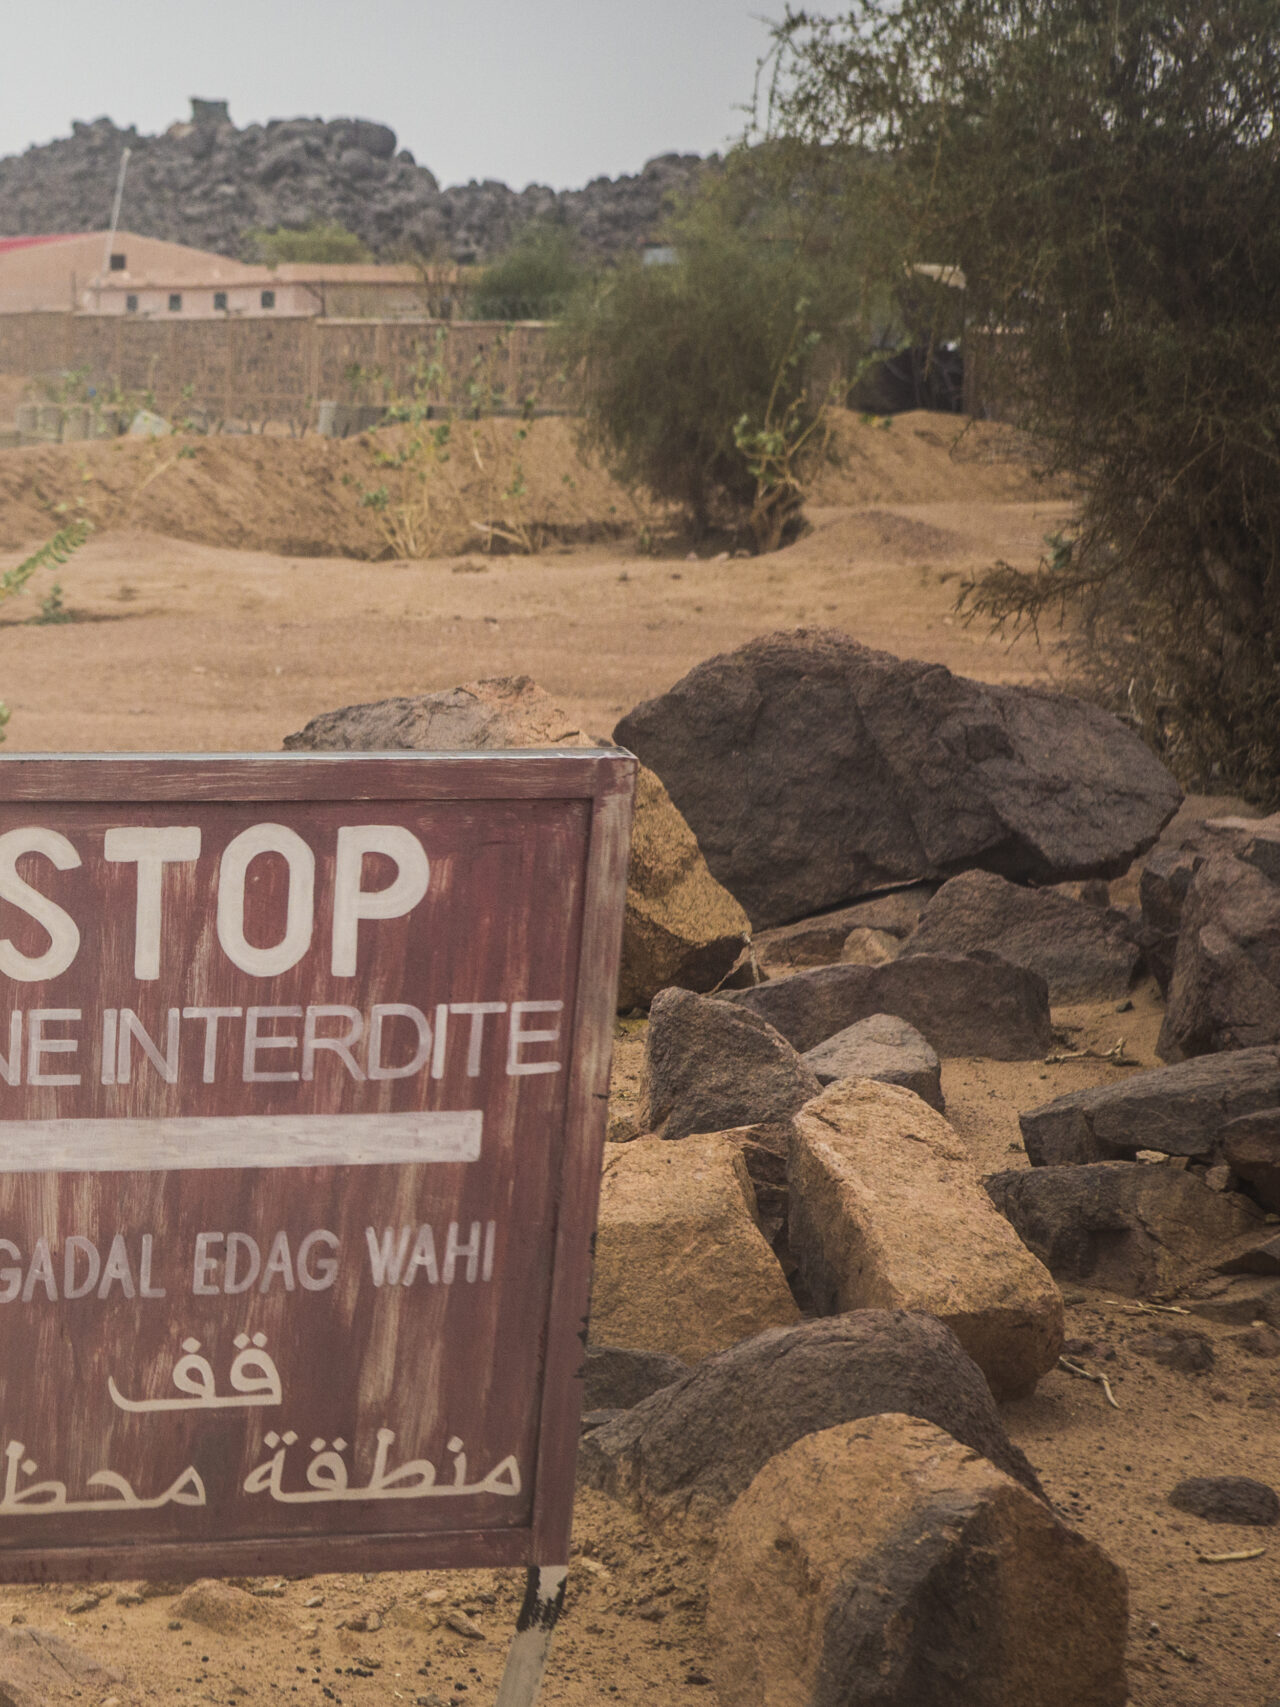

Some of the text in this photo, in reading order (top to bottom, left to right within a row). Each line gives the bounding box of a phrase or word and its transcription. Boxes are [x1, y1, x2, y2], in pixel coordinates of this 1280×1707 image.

[102, 1001, 563, 1085] INTERDITE
[192, 1229, 341, 1296] EDAG
[365, 1220, 497, 1287] WAHI
[107, 1332, 282, 1413] قف
[243, 1428, 522, 1504] منطقة
